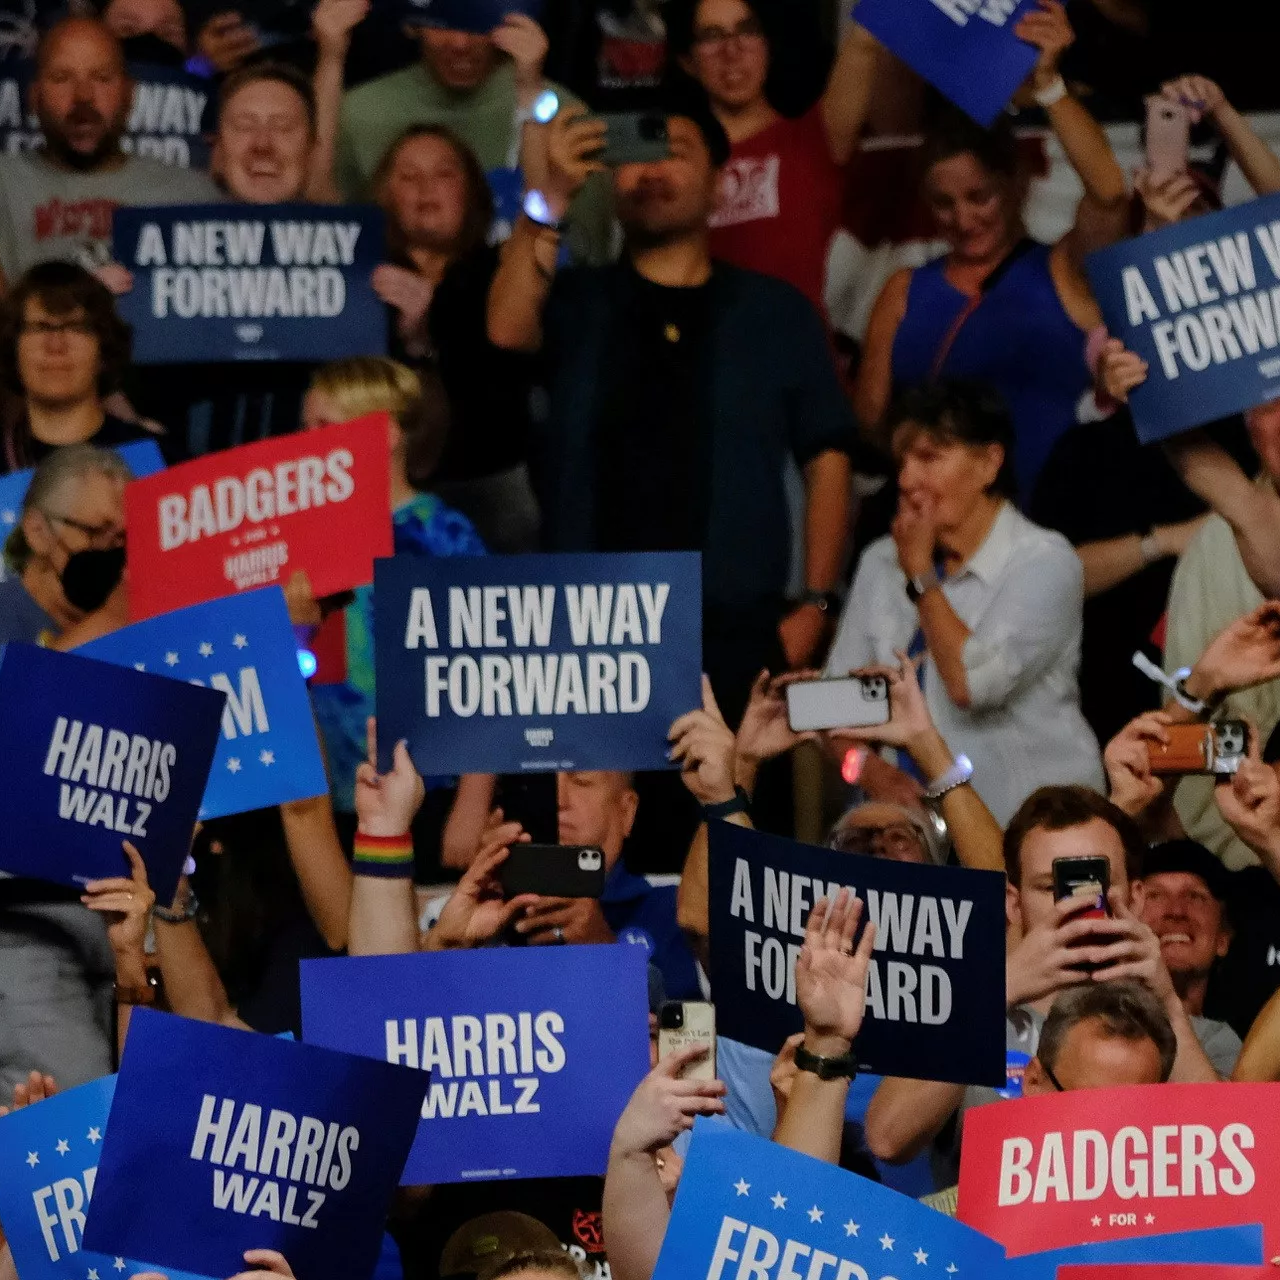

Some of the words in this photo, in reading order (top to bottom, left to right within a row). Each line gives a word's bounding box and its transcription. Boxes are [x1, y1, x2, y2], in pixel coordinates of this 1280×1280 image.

[134, 223, 167, 266] A
[172, 220, 265, 266] NEW
[271, 220, 362, 266] WAY
[152, 266, 346, 318] FORWARD
[1122, 265, 1160, 327] A
[1154, 231, 1256, 313] NEW
[158, 449, 354, 551] BADGERS
[405, 587, 439, 649] A
[448, 584, 555, 648] NEW
[565, 583, 670, 646] WAY
[425, 651, 651, 717] FORWARD
[44, 717, 176, 803] HARRIS
[59, 784, 150, 837] WALZ
[730, 857, 754, 923] A
[867, 889, 973, 960] WAY
[385, 1010, 566, 1075] HARRIS
[422, 1077, 540, 1119] WALZ
[190, 1095, 360, 1191] HARRIS
[997, 1123, 1255, 1206] BADGERS
[212, 1168, 326, 1229] WALZ
[1109, 1213, 1137, 1226] FOR
